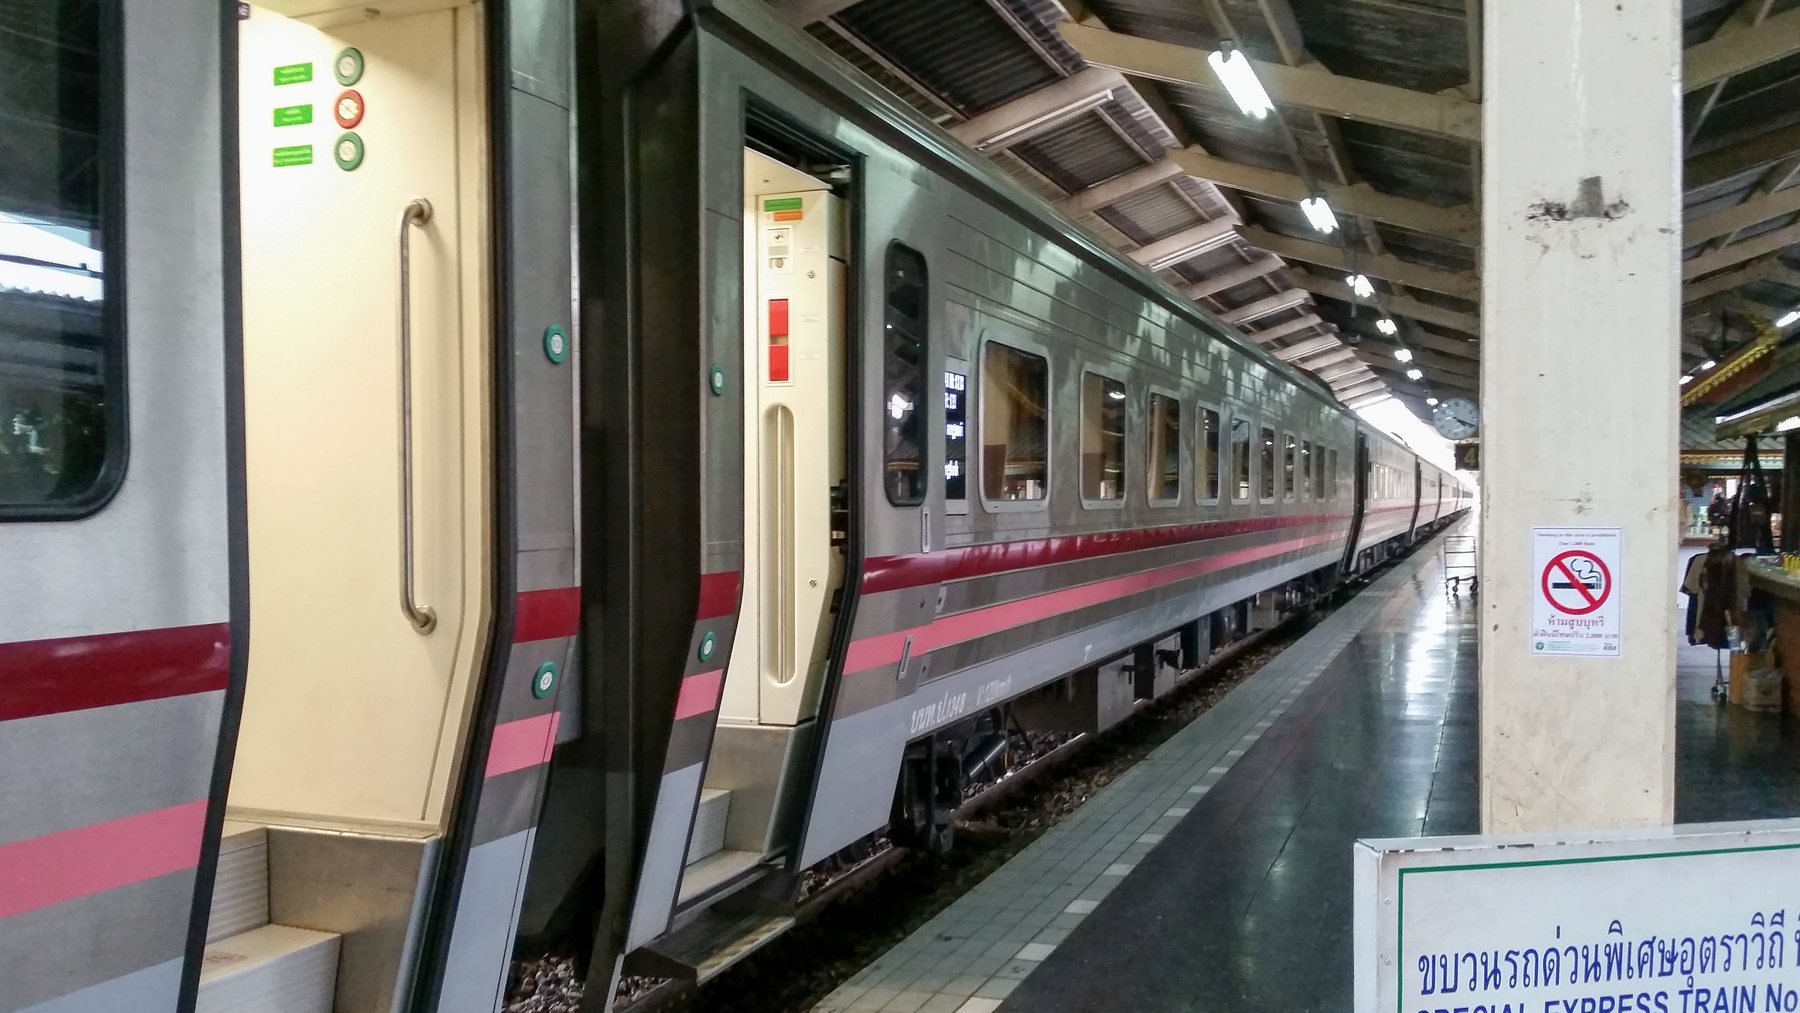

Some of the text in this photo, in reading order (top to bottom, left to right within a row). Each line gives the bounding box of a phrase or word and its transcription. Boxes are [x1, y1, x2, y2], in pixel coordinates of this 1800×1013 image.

[1418, 909, 1785, 995] ขบวนรถด่วนพิเศษอุตราวิถี
[1678, 984, 1757, 1013] TRAIN
